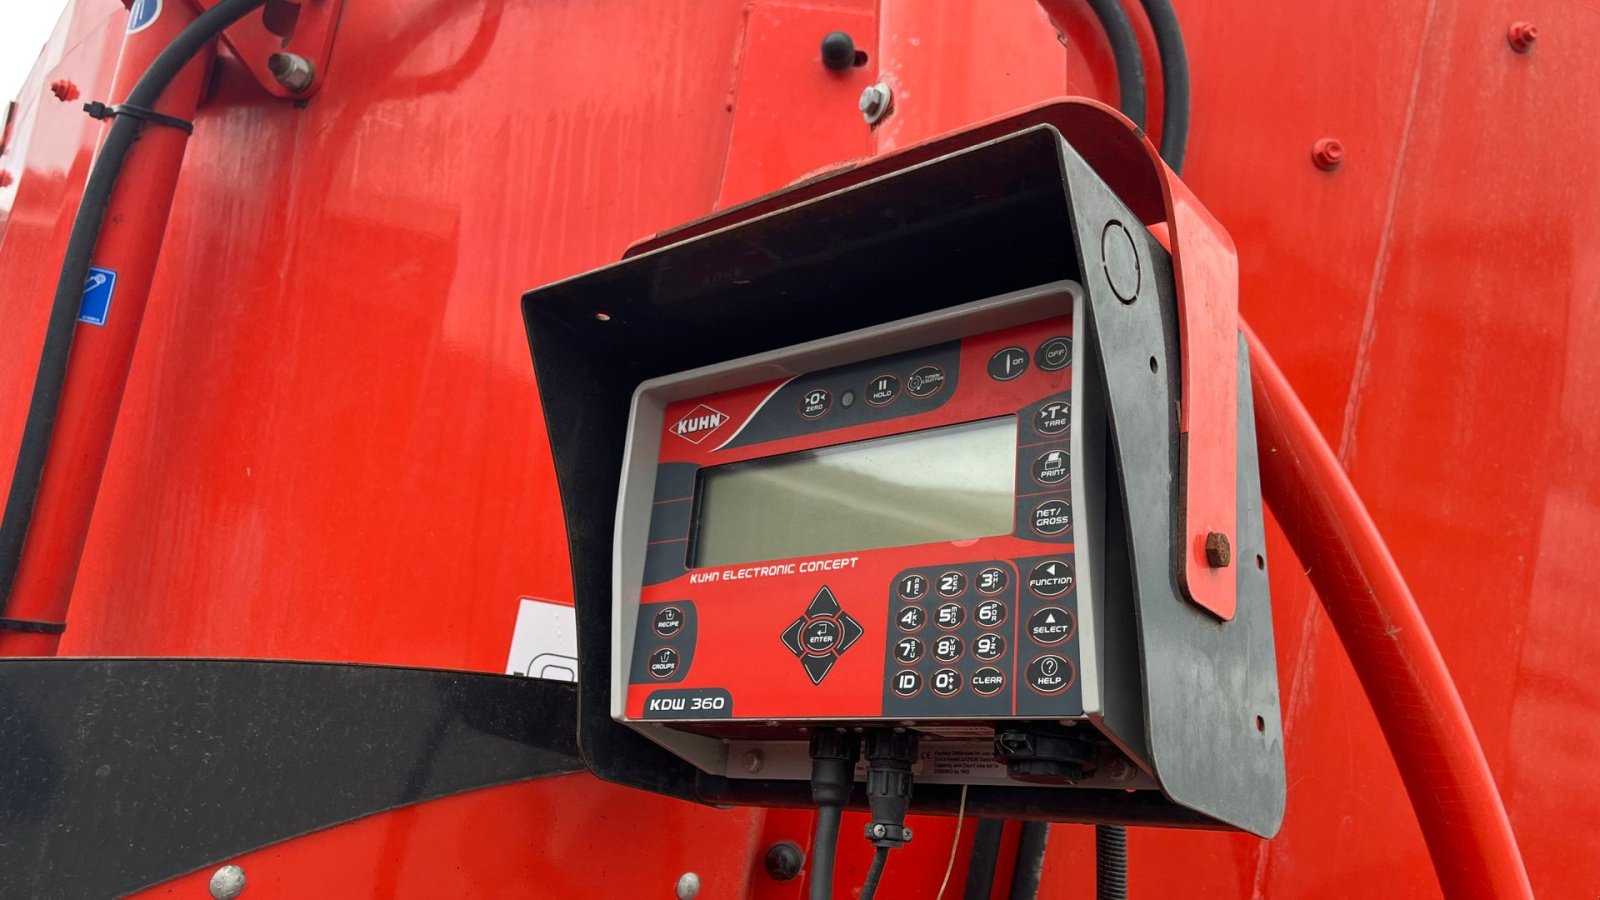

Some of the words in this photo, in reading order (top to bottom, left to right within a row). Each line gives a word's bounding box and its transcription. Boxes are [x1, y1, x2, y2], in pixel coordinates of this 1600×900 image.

[1048, 349, 1064, 358] OFF
[873, 390, 892, 398] HOLD
[806, 404, 823, 412] ZERO
[1048, 406, 1060, 418] T
[677, 413, 720, 434] KUHN
[1044, 418, 1066, 428] TARE
[1041, 468, 1066, 478] PRINT
[1036, 508, 1061, 518] NET/
[1036, 516, 1068, 526] GROSS
[690, 571, 720, 584] KUHN
[722, 563, 796, 580] ELECTRONIC
[800, 557, 858, 573] CONCEPT
[941, 577, 952, 590] 2
[981, 574, 993, 587] 3
[1030, 577, 1072, 586] FUNCTION
[906, 581, 911, 593] 1
[902, 611, 912, 624] 4
[939, 608, 951, 622] 5
[980, 606, 991, 620] 6
[658, 620, 679, 628] RECIPE
[1034, 625, 1068, 634] SELECT
[810, 636, 833, 644] ENTER
[978, 639, 990, 653] 9
[900, 643, 910, 656] 7
[938, 641, 950, 654] 8
[899, 675, 915, 688] ID
[936, 674, 948, 688] 0
[650, 698, 685, 711] KDW
[690, 697, 724, 710] 360
